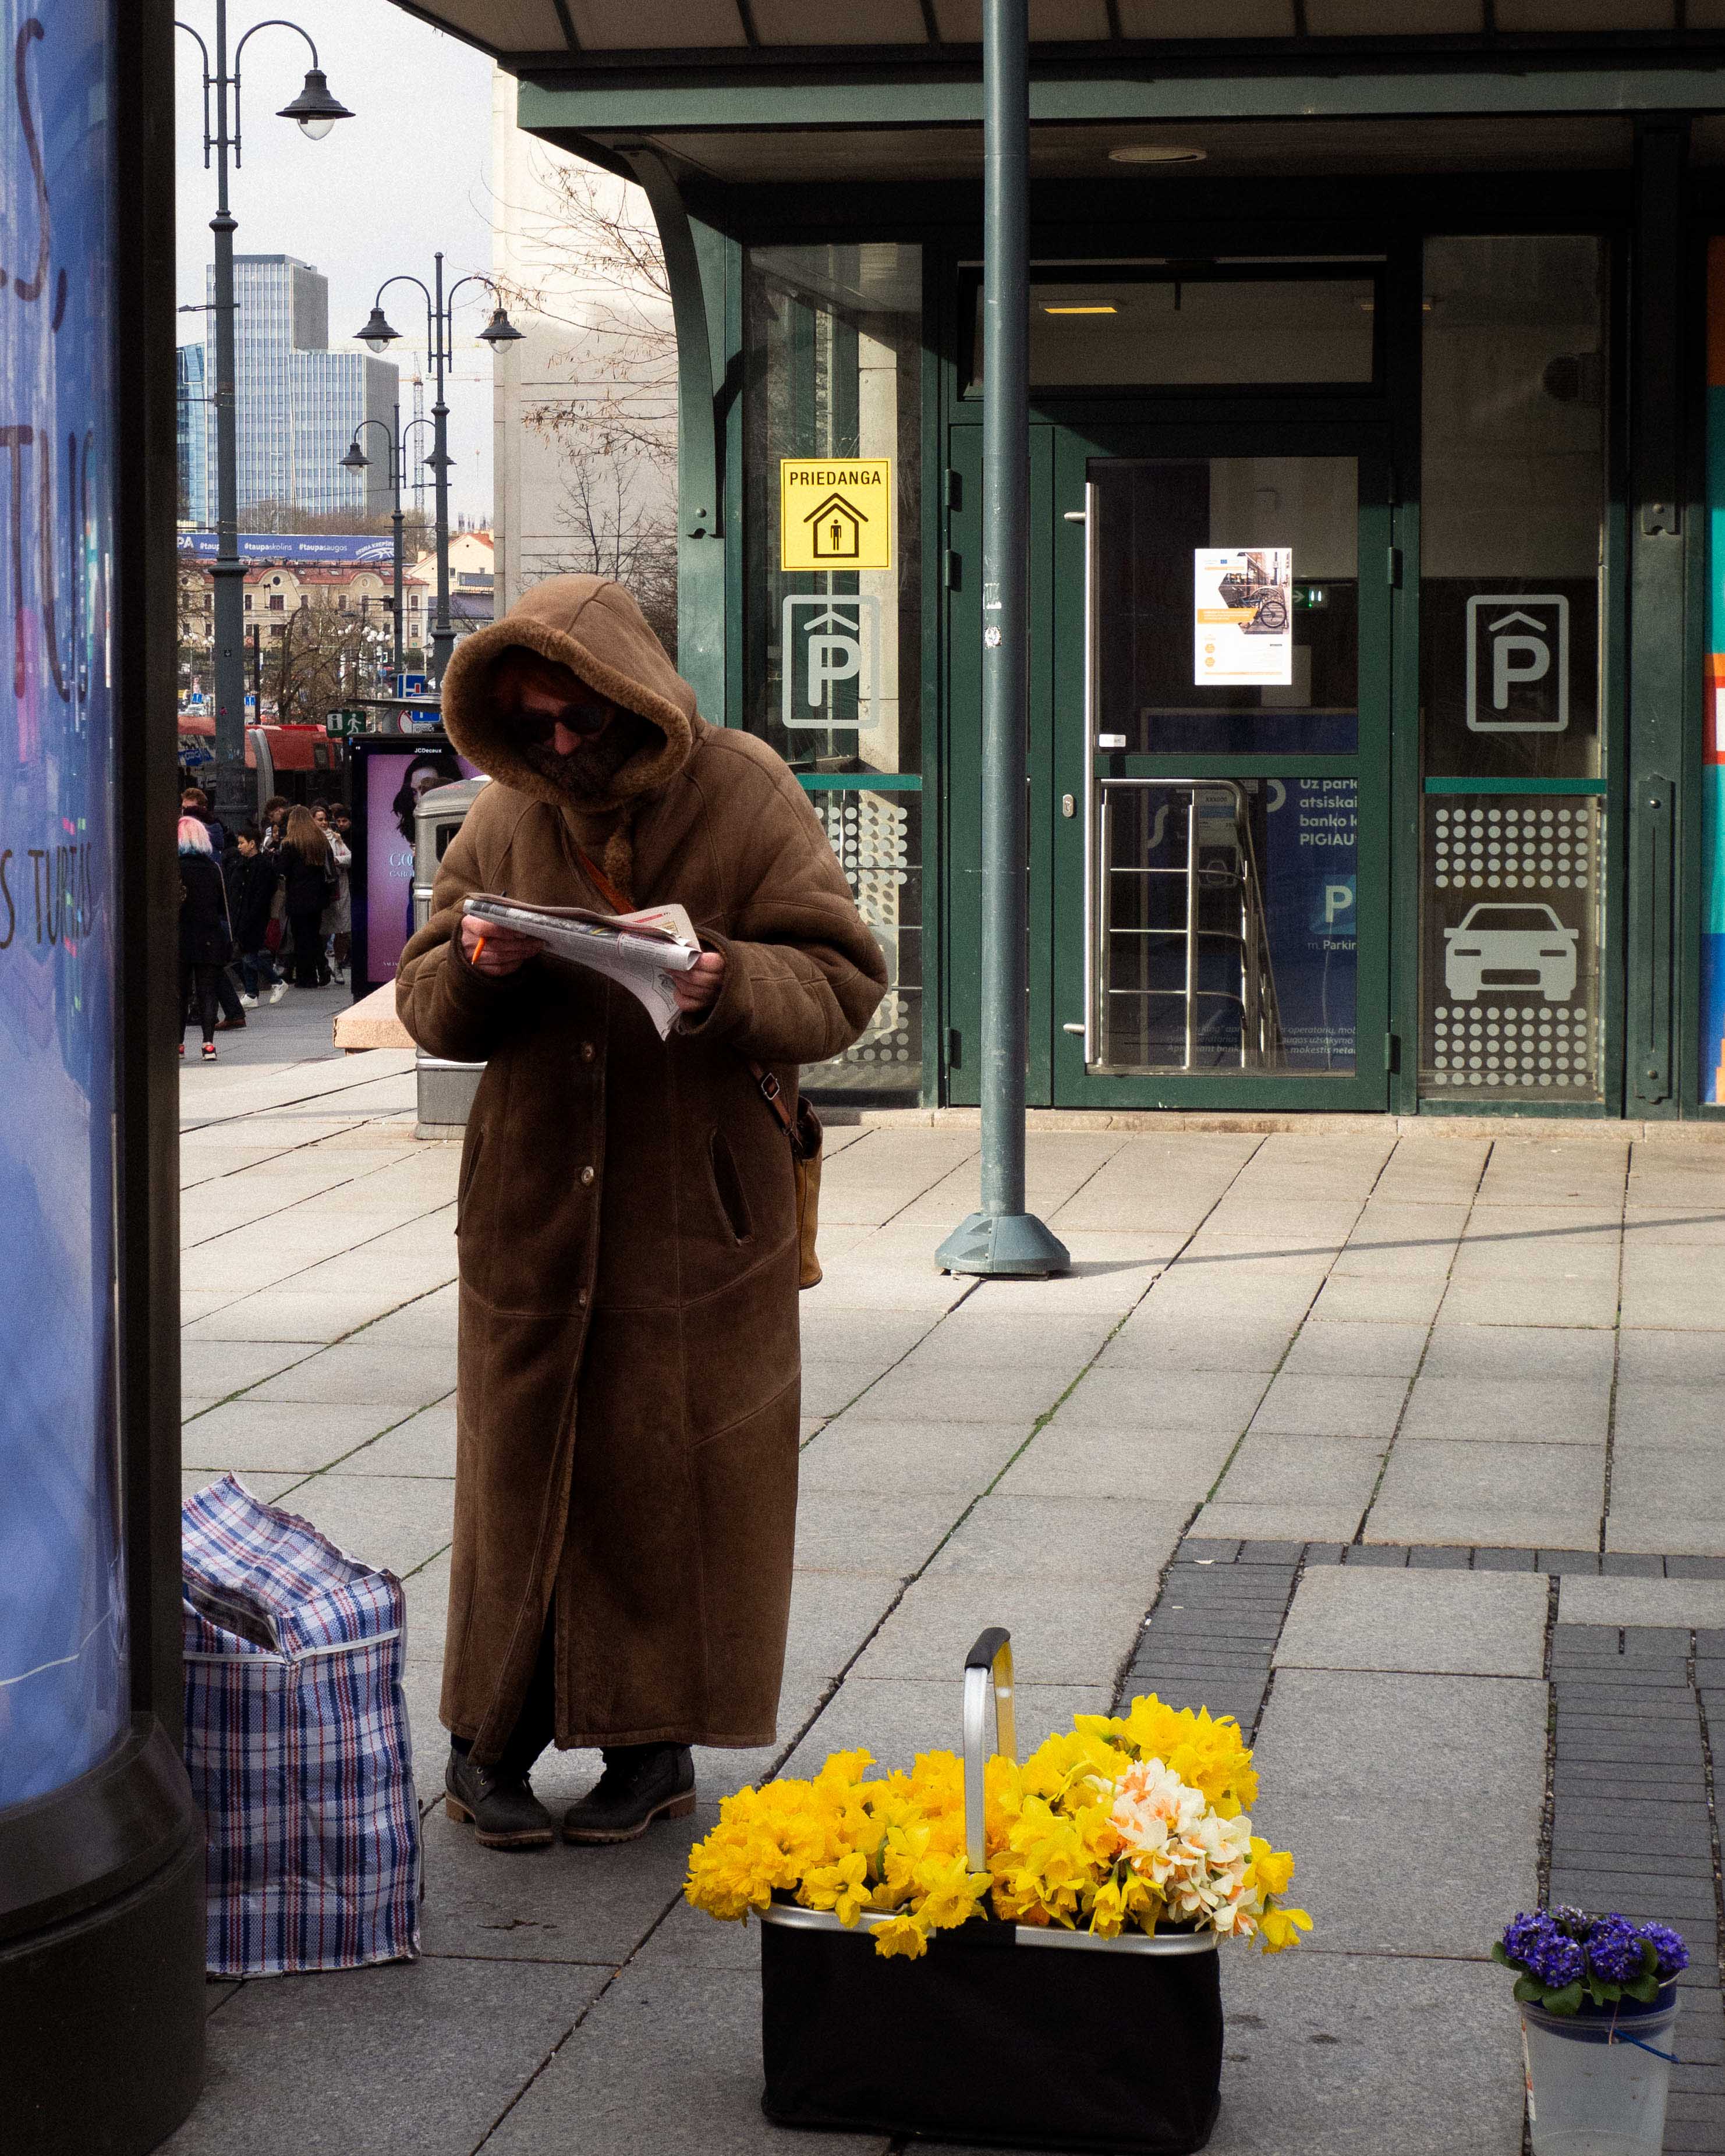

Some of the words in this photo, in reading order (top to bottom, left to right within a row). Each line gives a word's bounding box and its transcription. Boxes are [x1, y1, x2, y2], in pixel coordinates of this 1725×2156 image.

[790, 471, 881, 485] PRIEDANGA
[299, 543, 348, 553] #taupasaugos
[808, 634, 862, 707] P
[1494, 635, 1550, 710] P
[1299, 796, 1357, 808] atsiskai
[1299, 814, 1347, 827] banko
[1299, 833, 1357, 846] PIGIAU
[1325, 885, 1353, 923] P
